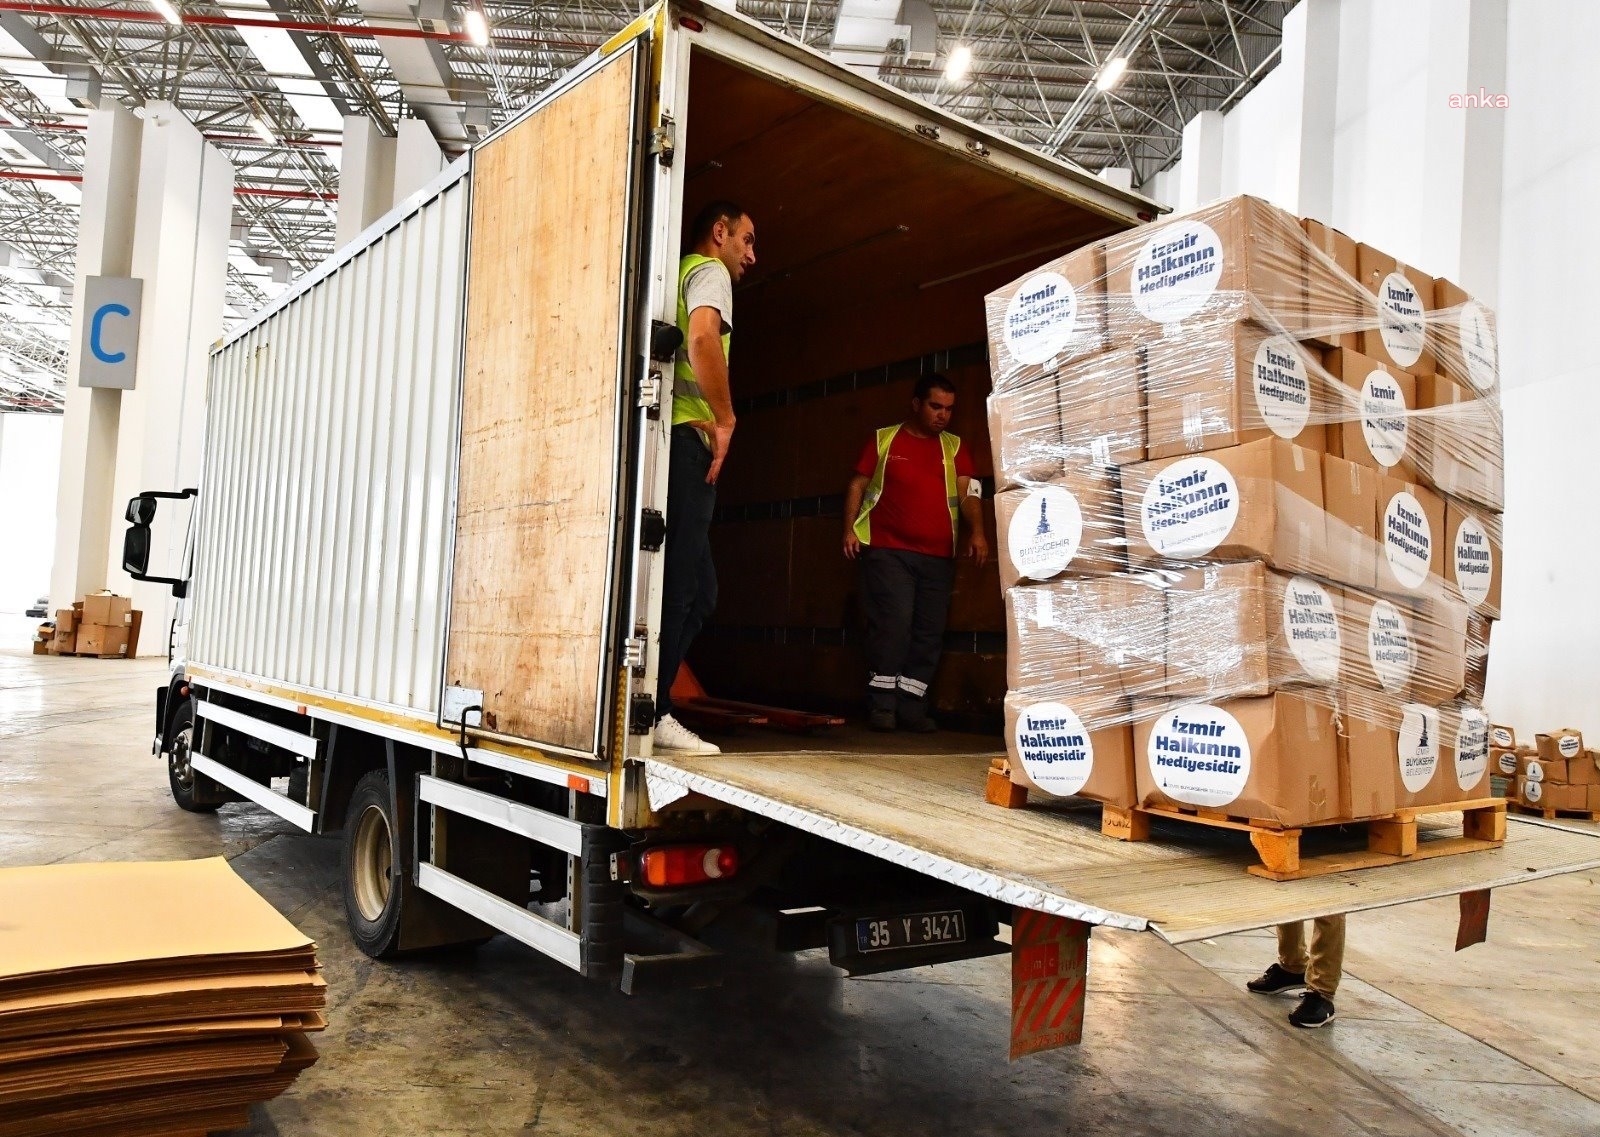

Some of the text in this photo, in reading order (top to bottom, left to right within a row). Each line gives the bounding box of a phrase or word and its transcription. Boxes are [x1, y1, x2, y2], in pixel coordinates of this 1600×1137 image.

[1152, 233, 1199, 260] İzmir
[1138, 246, 1214, 281] Halkının
[1140, 261, 1216, 294] Hediyesidir
[1387, 282, 1414, 302] İzmir
[90, 303, 131, 364] C
[1266, 346, 1296, 371] İzmir
[1258, 364, 1306, 391] Halkının
[1259, 384, 1307, 404] Hediyesidir
[1370, 381, 1396, 400] İzmir
[1397, 500, 1422, 527] İzmir
[1388, 514, 1429, 548] Halkının
[1463, 527, 1482, 545] İzmir
[1388, 532, 1428, 561] Hediyesidir
[1457, 546, 1489, 561] Halkının
[1458, 562, 1490, 575] Hediyesidir
[1026, 714, 1067, 731] İzmir
[1171, 715, 1226, 737] İzmir
[1019, 733, 1084, 748] Halkının
[1155, 735, 1241, 758] Halkının
[1024, 749, 1086, 764] Hediyesidir
[1156, 754, 1241, 774] Hediyesidir
[869, 914, 960, 947] 35 Y 3421
